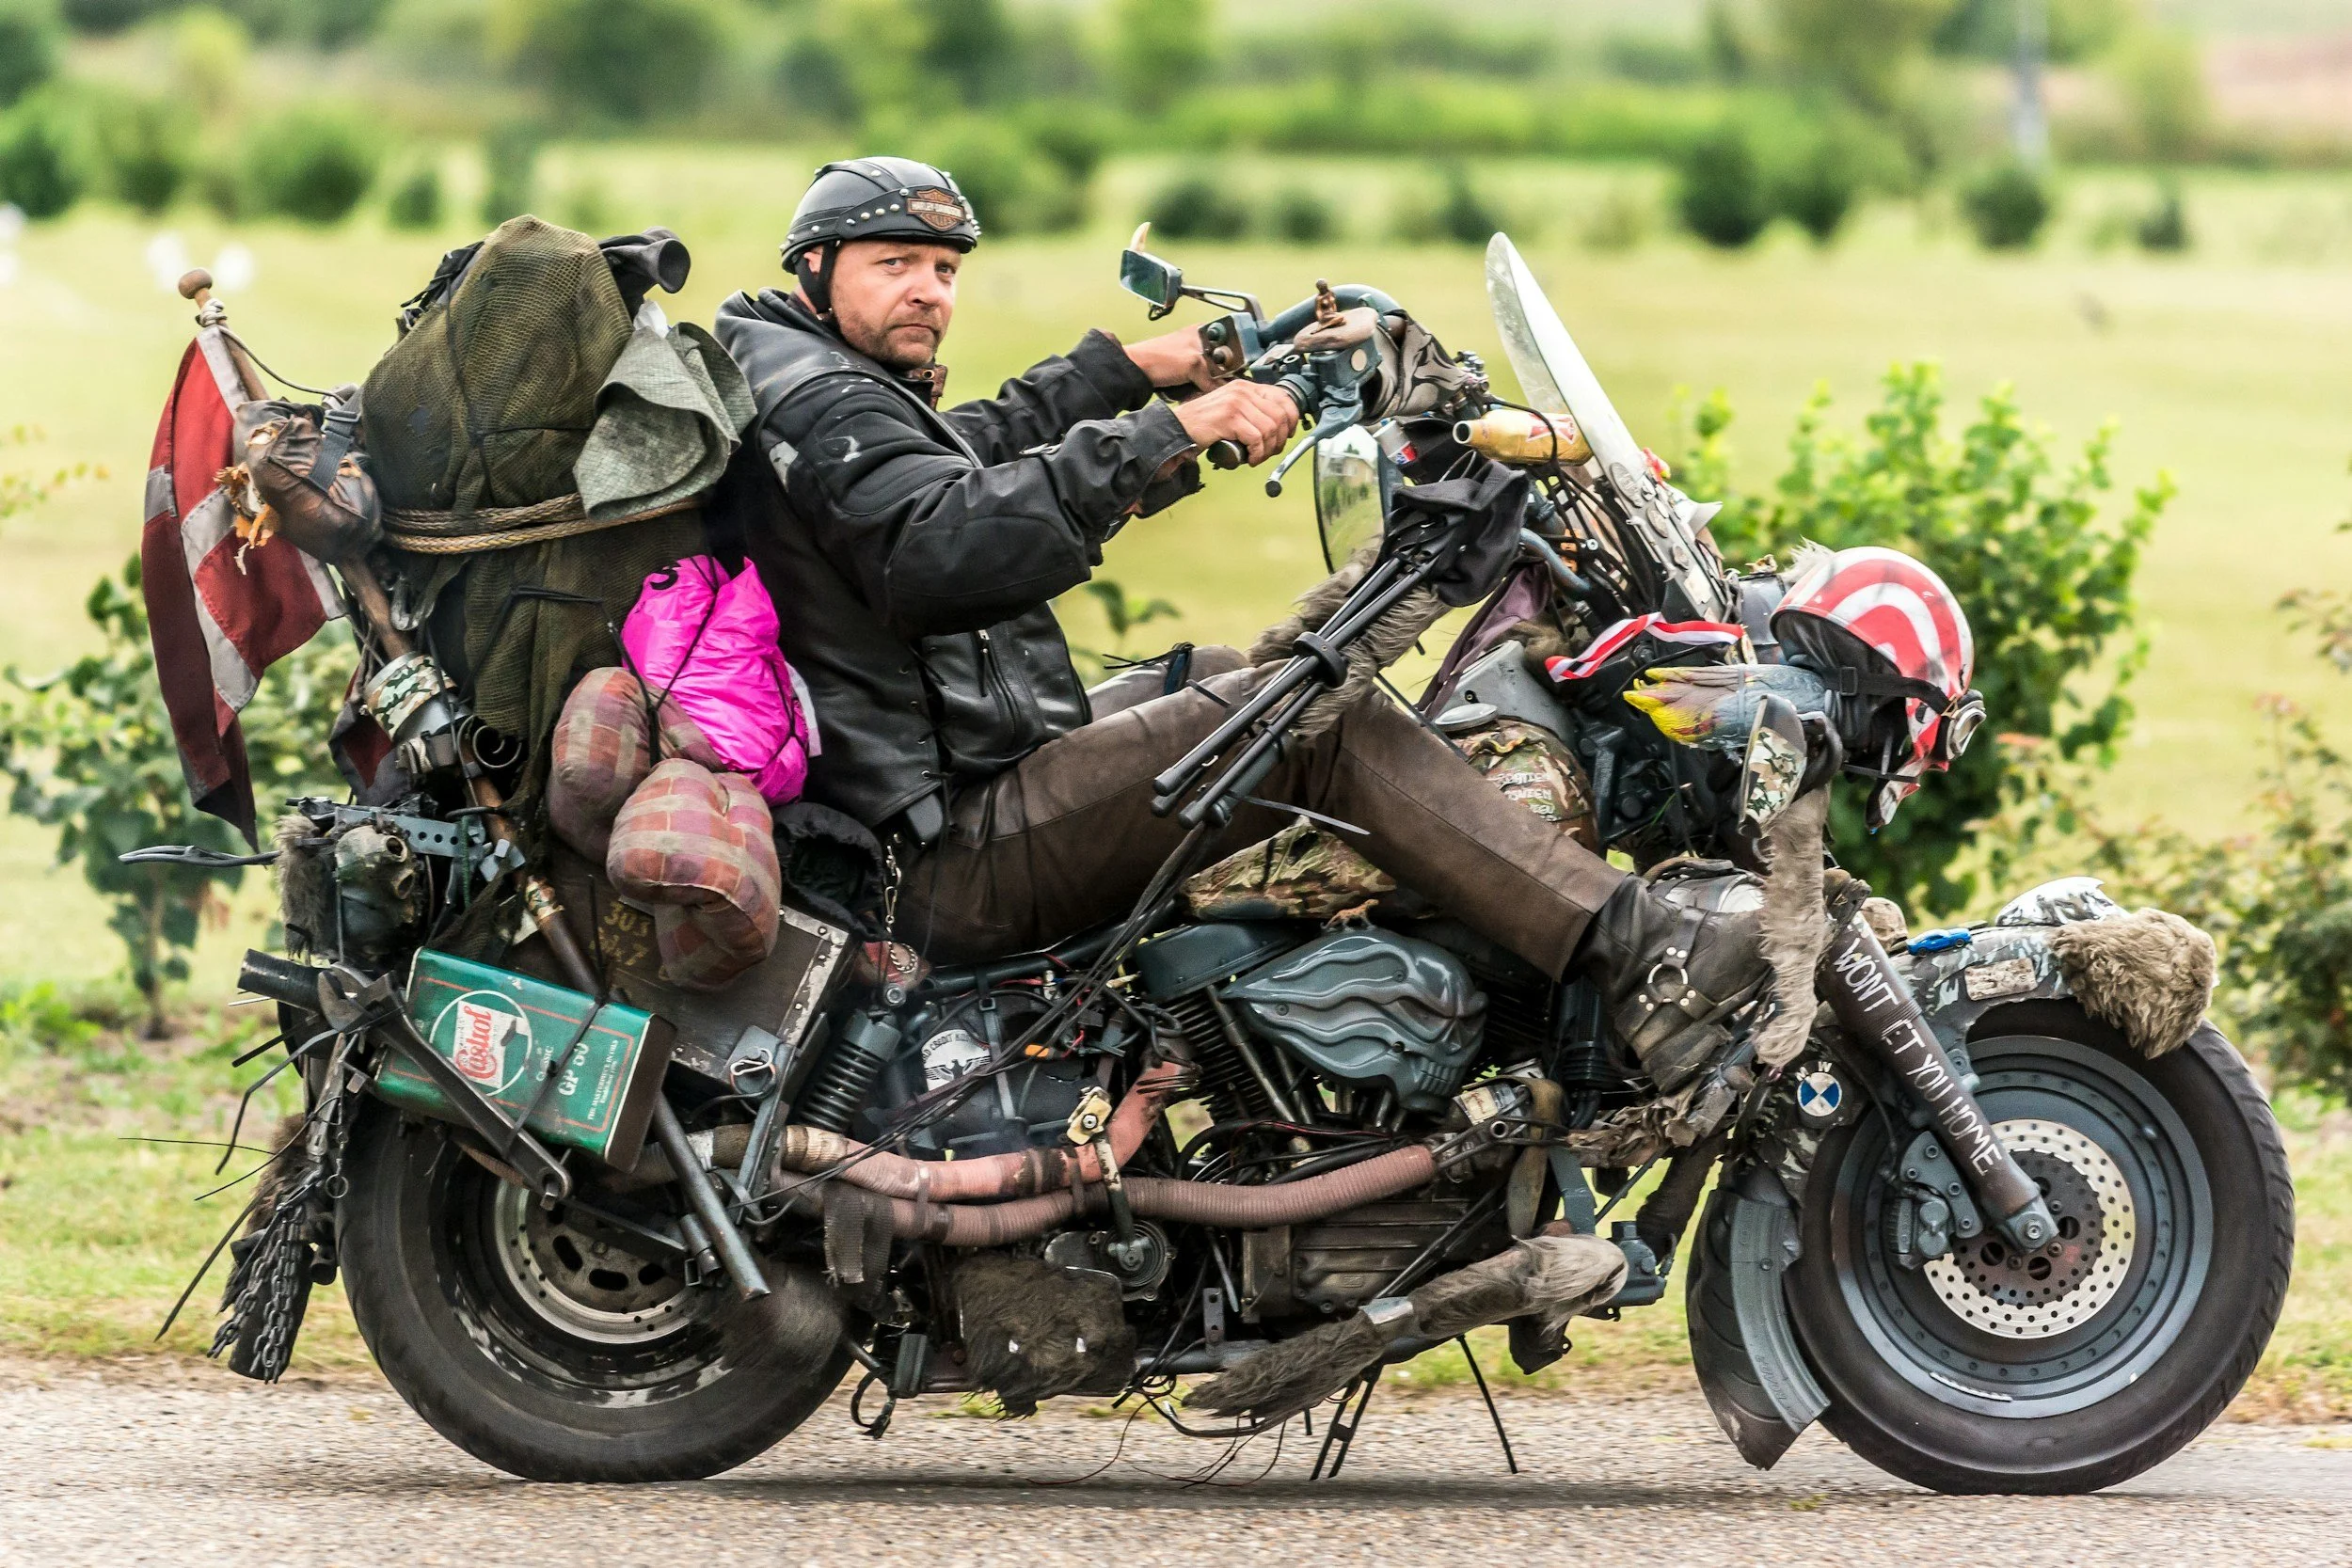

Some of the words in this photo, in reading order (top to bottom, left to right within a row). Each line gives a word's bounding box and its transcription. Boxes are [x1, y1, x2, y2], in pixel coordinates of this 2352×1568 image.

[456, 1006, 497, 1079] Castrol
[558, 1069, 579, 1096] GP
[1906, 1053, 1955, 1102] YOU
[1938, 1096, 2003, 1177] HOME
